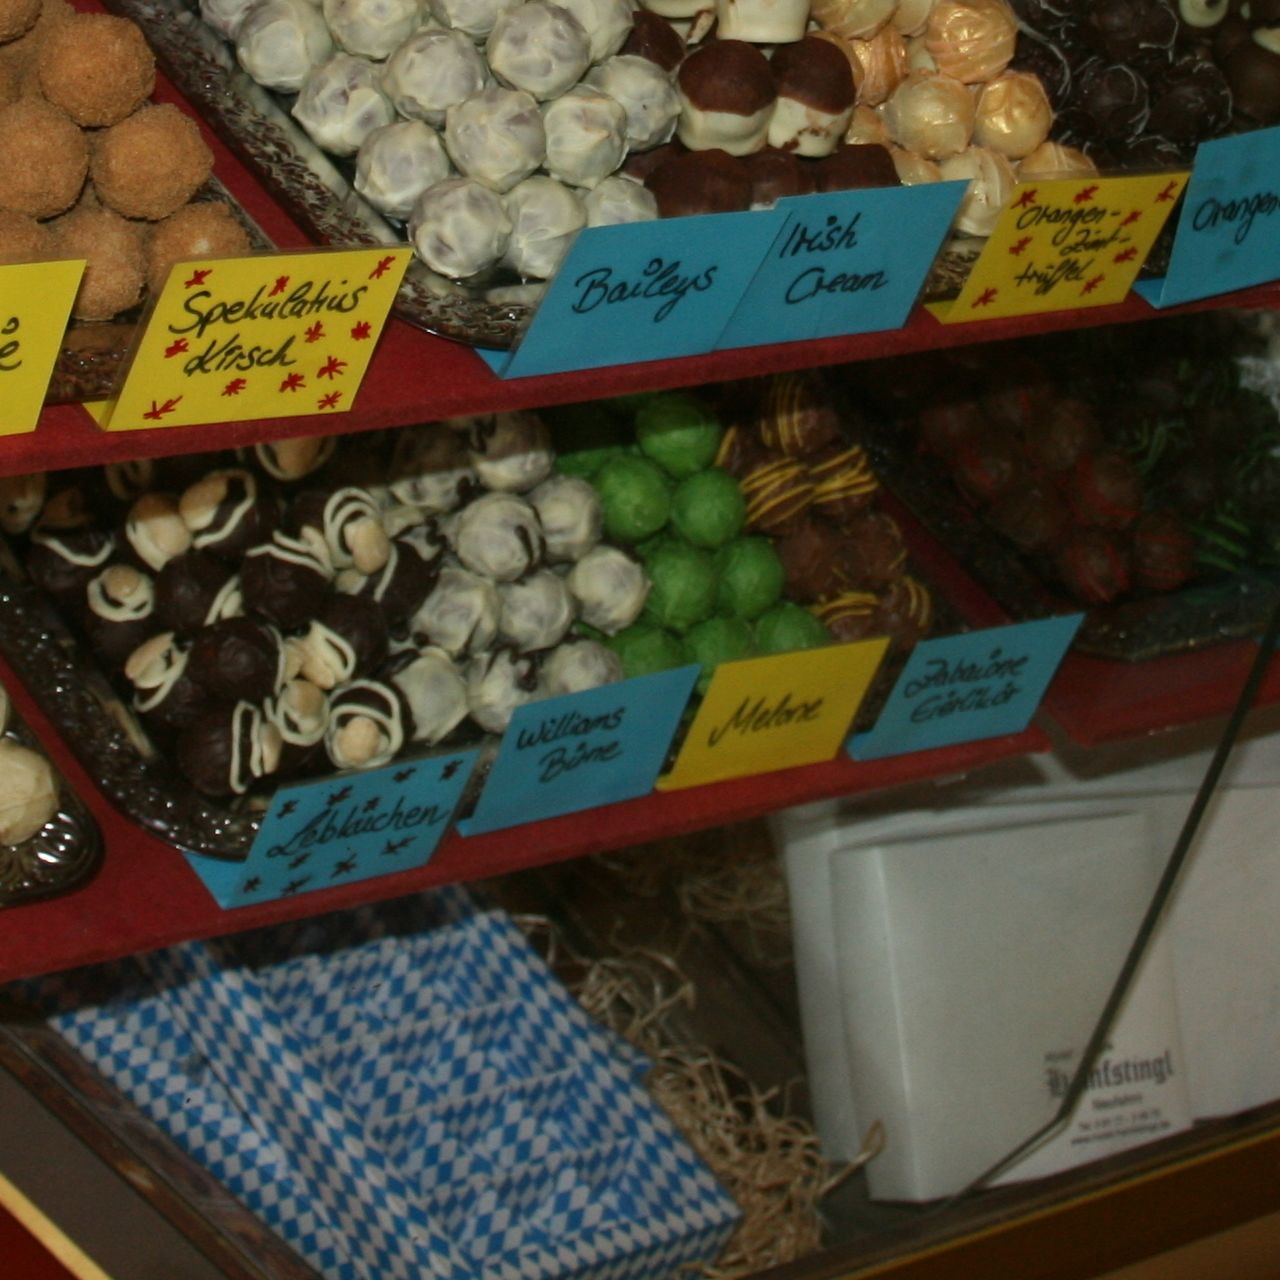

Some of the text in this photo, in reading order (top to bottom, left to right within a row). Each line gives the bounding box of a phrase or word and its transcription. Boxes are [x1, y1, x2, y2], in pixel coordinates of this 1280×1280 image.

[778, 212, 862, 259] Irish
[571, 257, 719, 323] Baileys
[785, 266, 889, 305] Cream
